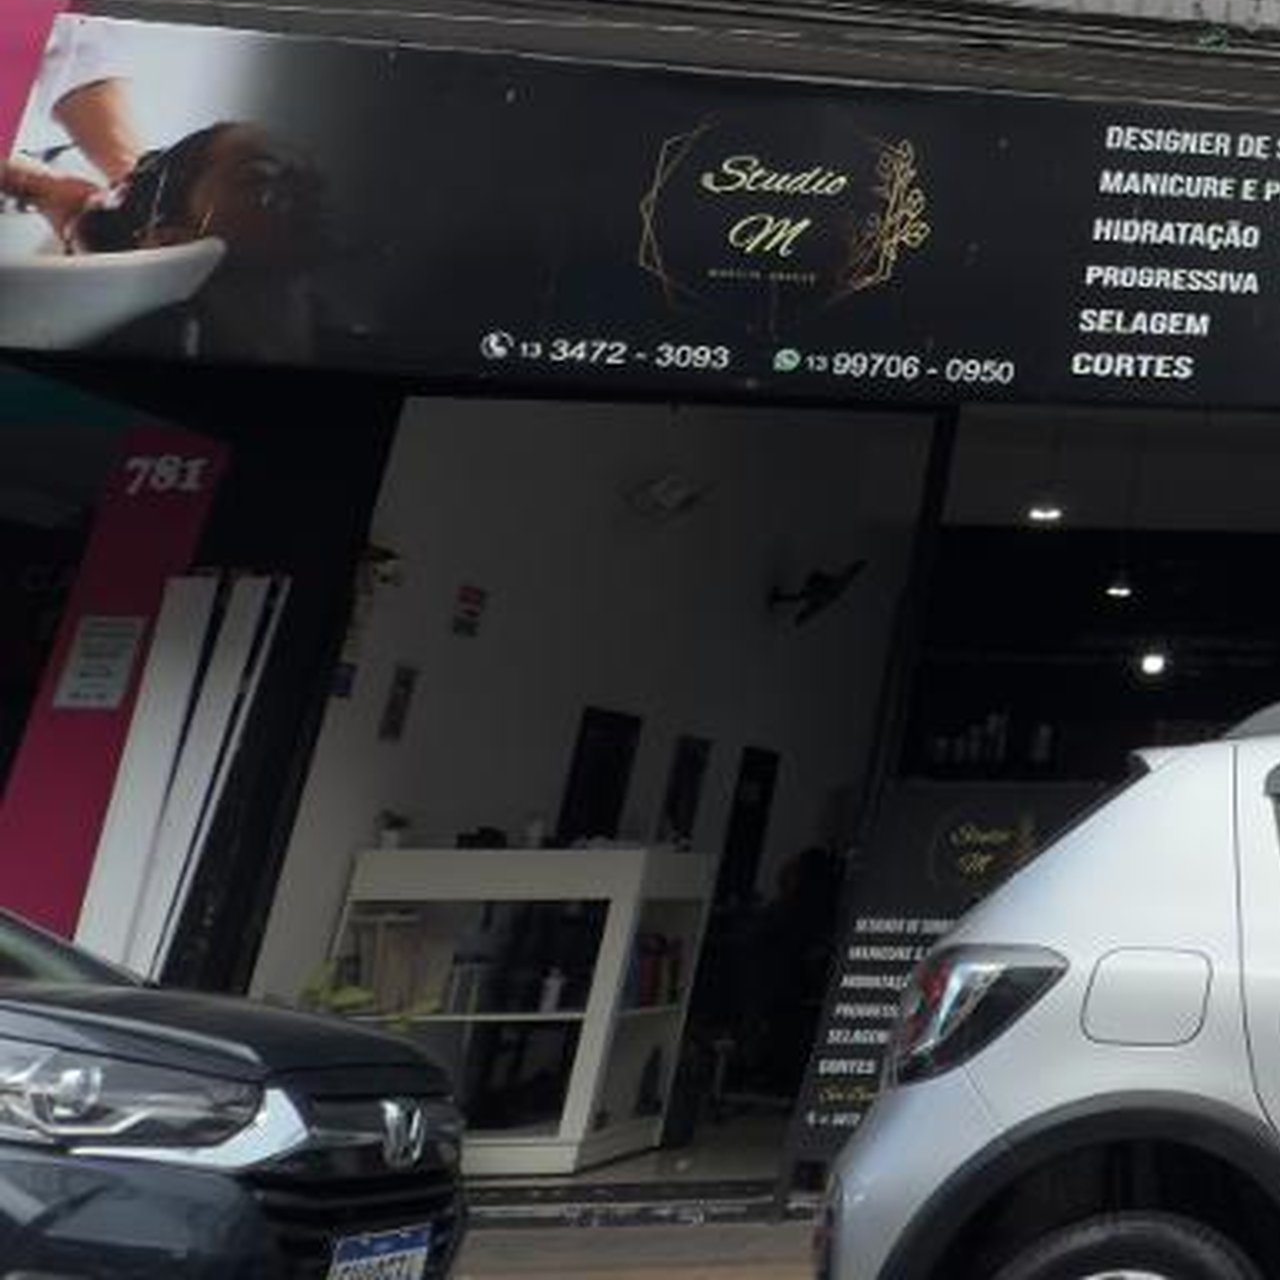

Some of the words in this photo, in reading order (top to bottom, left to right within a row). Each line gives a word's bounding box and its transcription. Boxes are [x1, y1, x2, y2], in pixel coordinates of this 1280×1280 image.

[1105, 126, 1231, 157] DESIGNER
[1236, 134, 1273, 159] DE
[702, 154, 848, 196] Studio
[1099, 170, 1235, 199] MANICURE
[1242, 178, 1260, 202] E
[727, 213, 811, 257] M
[1093, 217, 1260, 251] HIDRATAÇÃO
[1085, 266, 1259, 294] PROGRESSIVA
[1079, 309, 1210, 336] SELAGEM
[520, 341, 542, 358] 13
[550, 339, 627, 365] 3472
[655, 342, 731, 368] 3093
[806, 354, 829, 371] 13
[833, 352, 920, 379] 99706
[946, 358, 1016, 384] 0950
[1072, 352, 1195, 379] CORTES
[126, 456, 209, 496] 781
